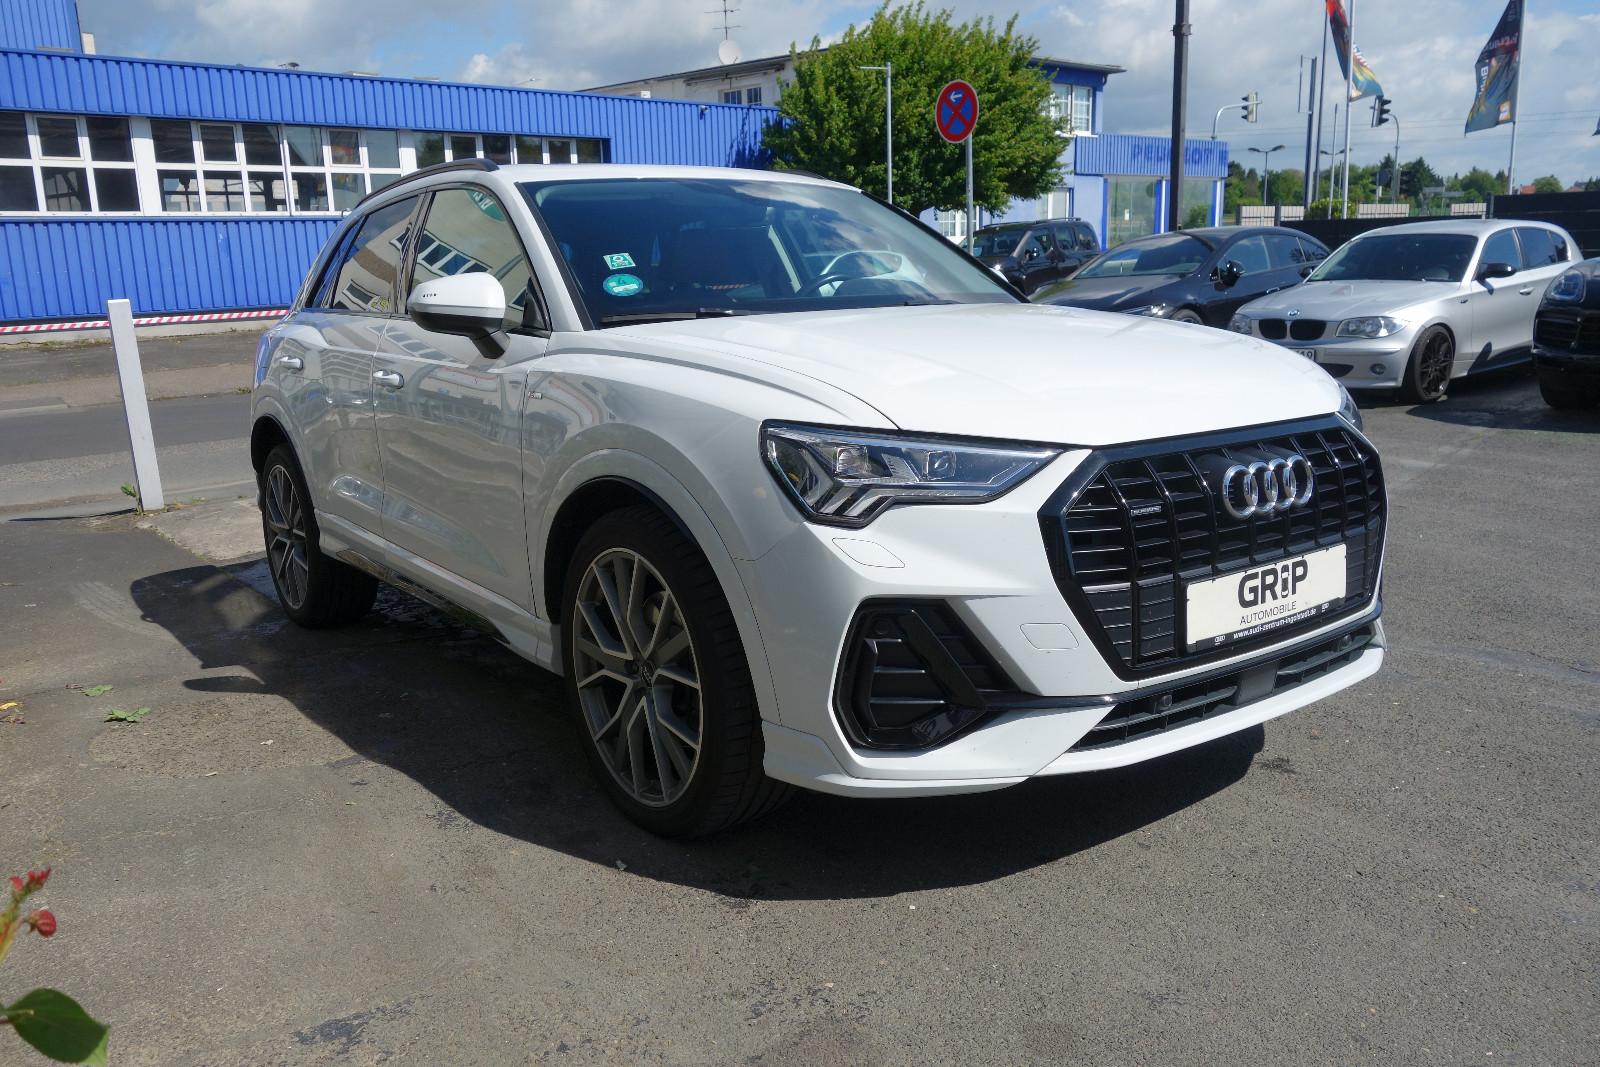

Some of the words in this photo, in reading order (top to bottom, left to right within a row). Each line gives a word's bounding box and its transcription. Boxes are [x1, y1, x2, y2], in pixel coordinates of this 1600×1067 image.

[1132, 143, 1213, 165] PEUOT
[1238, 559, 1308, 609] GRIP
[1239, 601, 1297, 626] AUTOMOBILE
